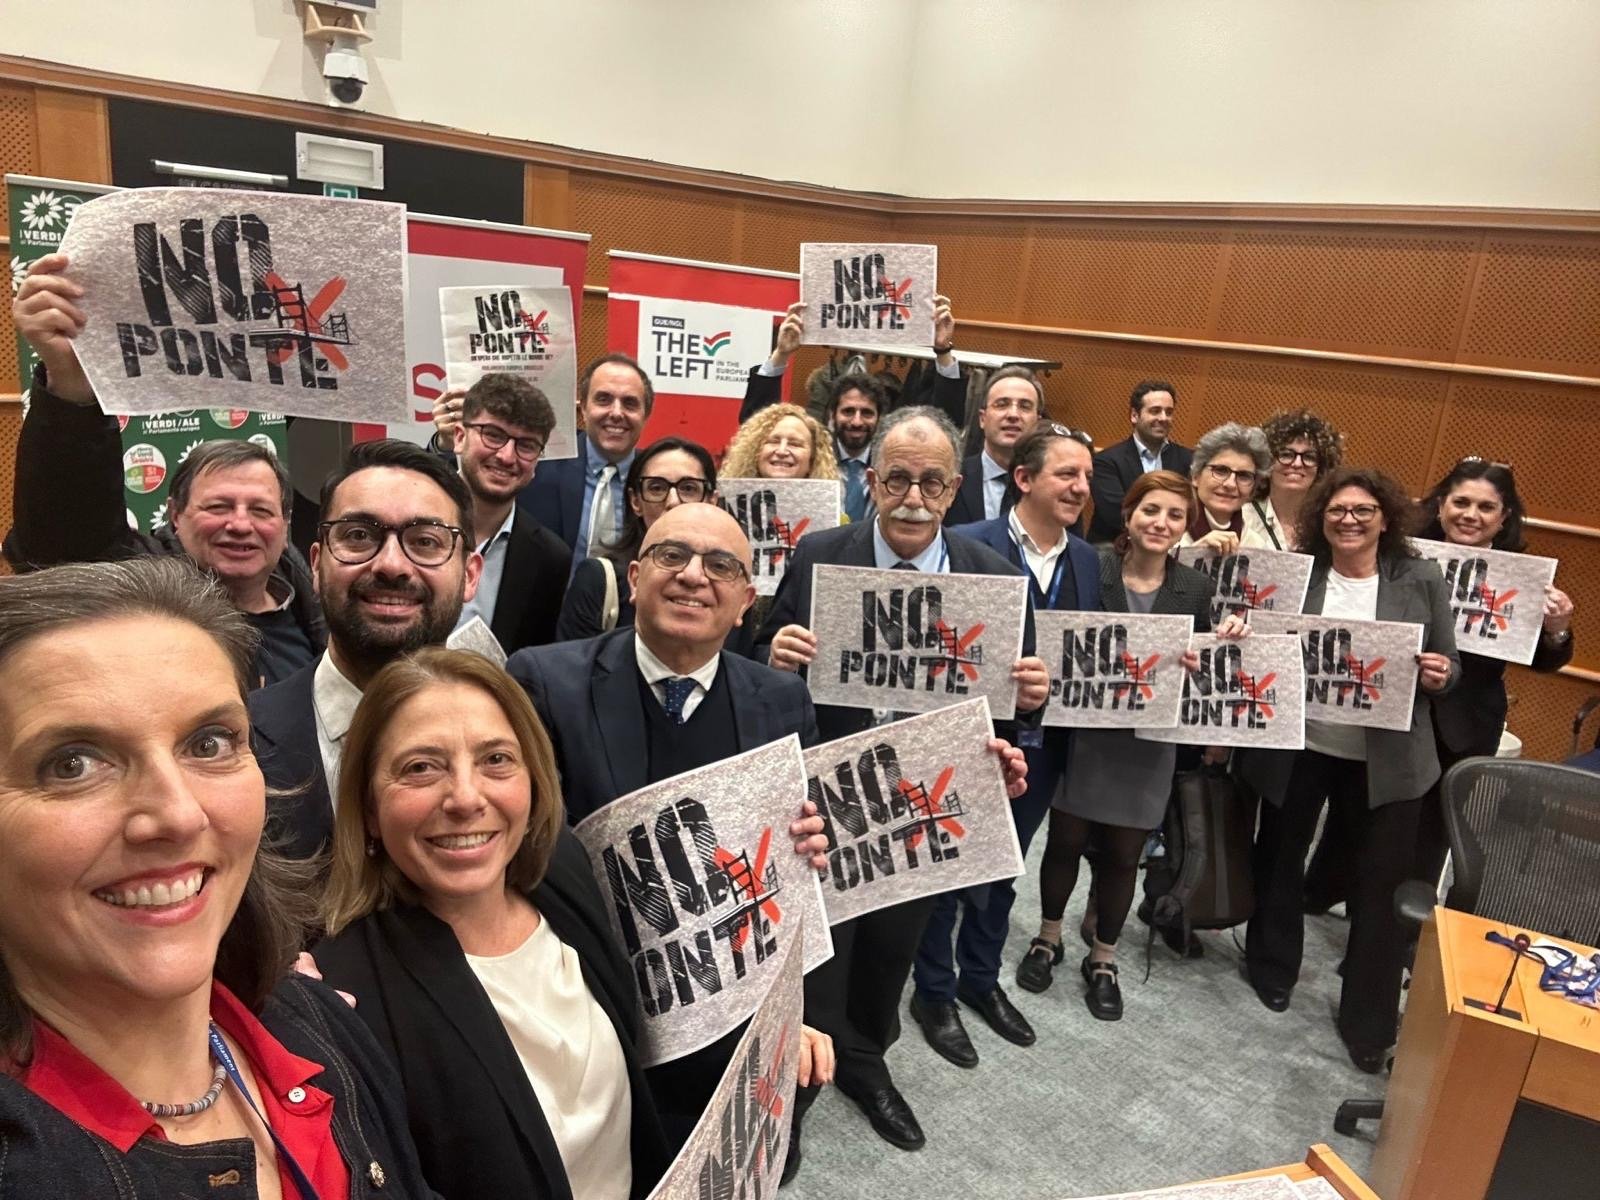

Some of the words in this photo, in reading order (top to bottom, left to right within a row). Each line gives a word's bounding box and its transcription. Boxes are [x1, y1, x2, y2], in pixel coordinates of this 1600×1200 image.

[24, 230, 62, 242] VERDI
[133, 212, 277, 327] NO
[833, 253, 886, 305] NO
[475, 290, 522, 334] NO
[821, 303, 904, 330] PONTE
[116, 322, 338, 391] PONTE
[469, 332, 545, 355] PONTE
[652, 331, 700, 355] THE
[656, 355, 714, 380] LEFT
[716, 368, 748, 376] EUROPEA
[862, 585, 943, 653] NO
[840, 650, 969, 695] PONTE
[1062, 624, 1129, 680] NO
[1181, 698, 1267, 729] ONTE
[1304, 678, 1372, 710] NTE
[807, 743, 908, 854] NO
[602, 797, 732, 957] NO
[828, 818, 960, 892] ONTE
[634, 903, 778, 1018] ONTE
[211, 1033, 236, 1073] Parliament
